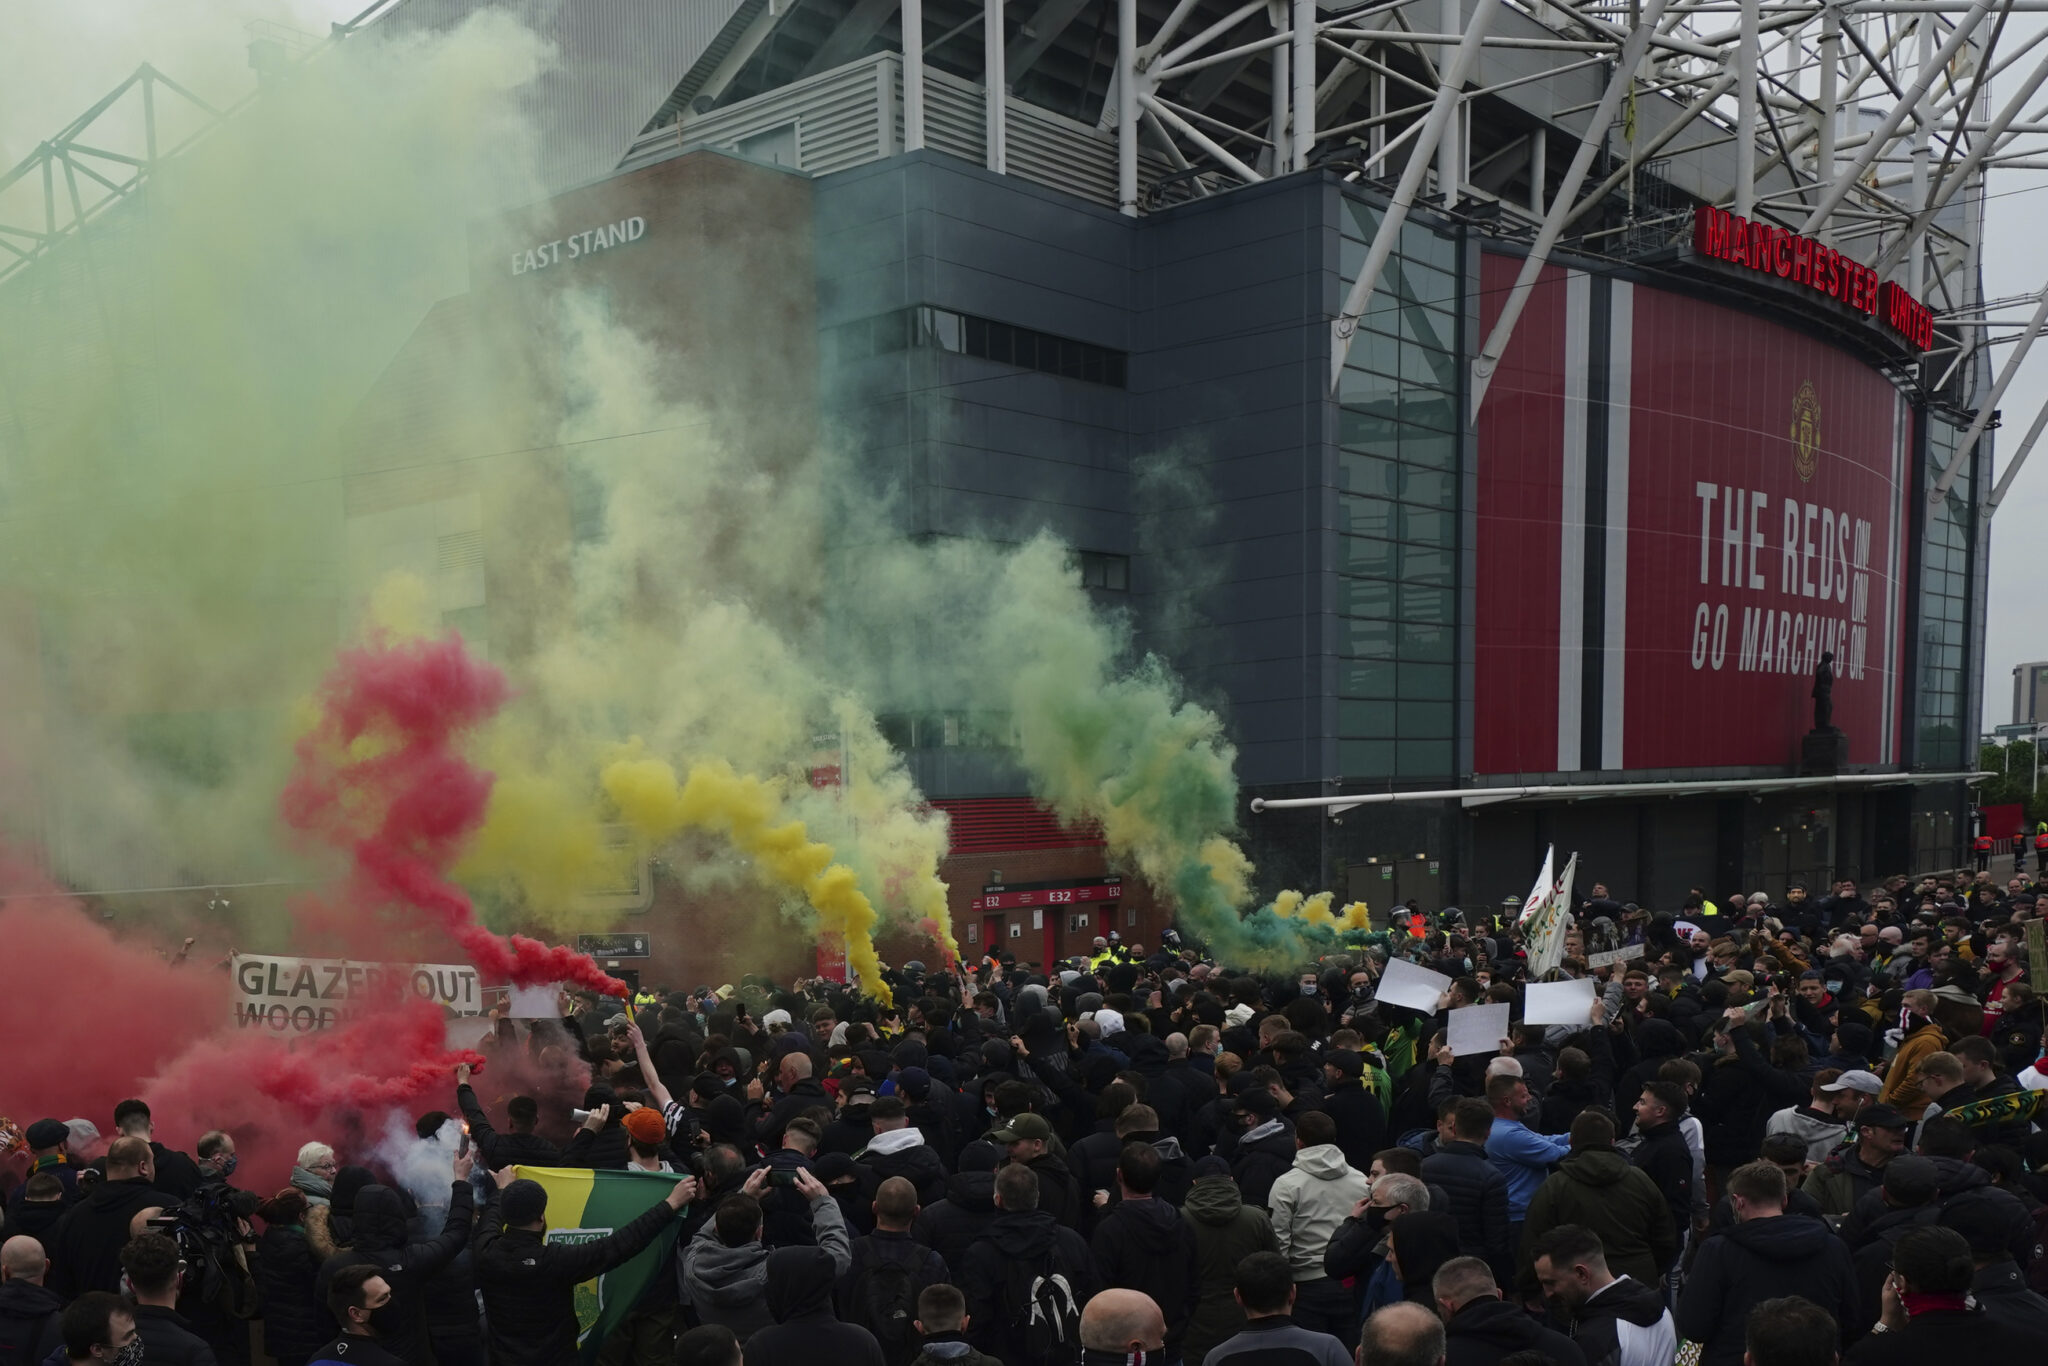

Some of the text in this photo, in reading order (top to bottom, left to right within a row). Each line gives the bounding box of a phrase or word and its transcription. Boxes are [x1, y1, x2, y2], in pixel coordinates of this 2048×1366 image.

[511, 215, 646, 276] EAST STAND
[1702, 206, 1933, 351] MANCHESTER UNITED
[1696, 481, 1850, 604] THE REDS
[1691, 602, 1847, 679] GO MARCHING
[986, 896, 1000, 907] E32
[1049, 890, 1072, 902] E32
[1108, 886, 1121, 897] E32
[411, 970, 476, 1003] OUT
